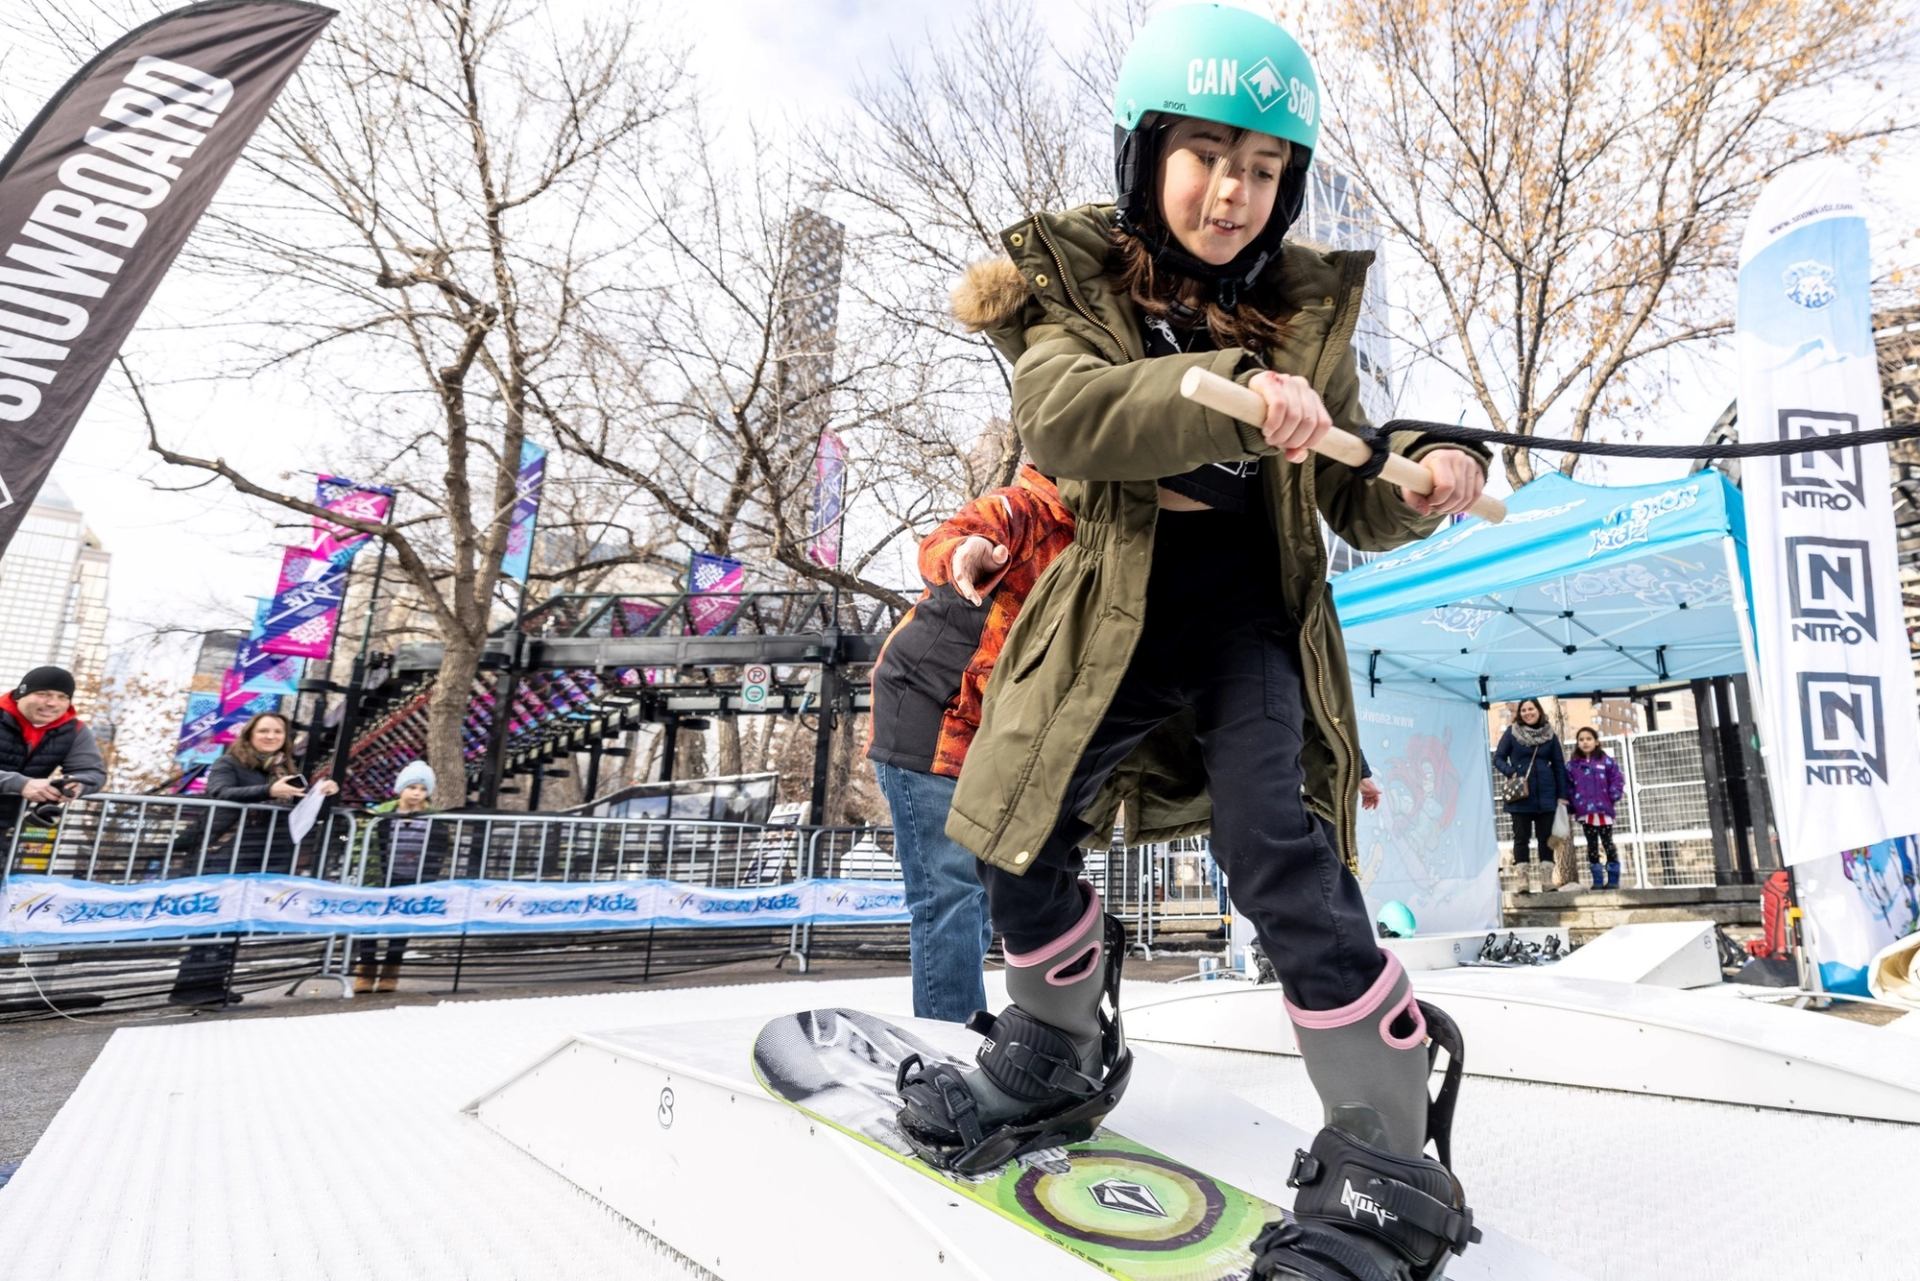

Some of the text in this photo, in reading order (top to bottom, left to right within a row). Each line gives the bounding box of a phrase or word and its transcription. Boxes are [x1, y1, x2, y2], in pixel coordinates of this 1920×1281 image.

[1187, 58, 1316, 127] CAN SBD
[1782, 490, 1852, 511] NITRO
[1791, 622, 1862, 645] NITRO
[1805, 765, 1873, 787] NITRO
